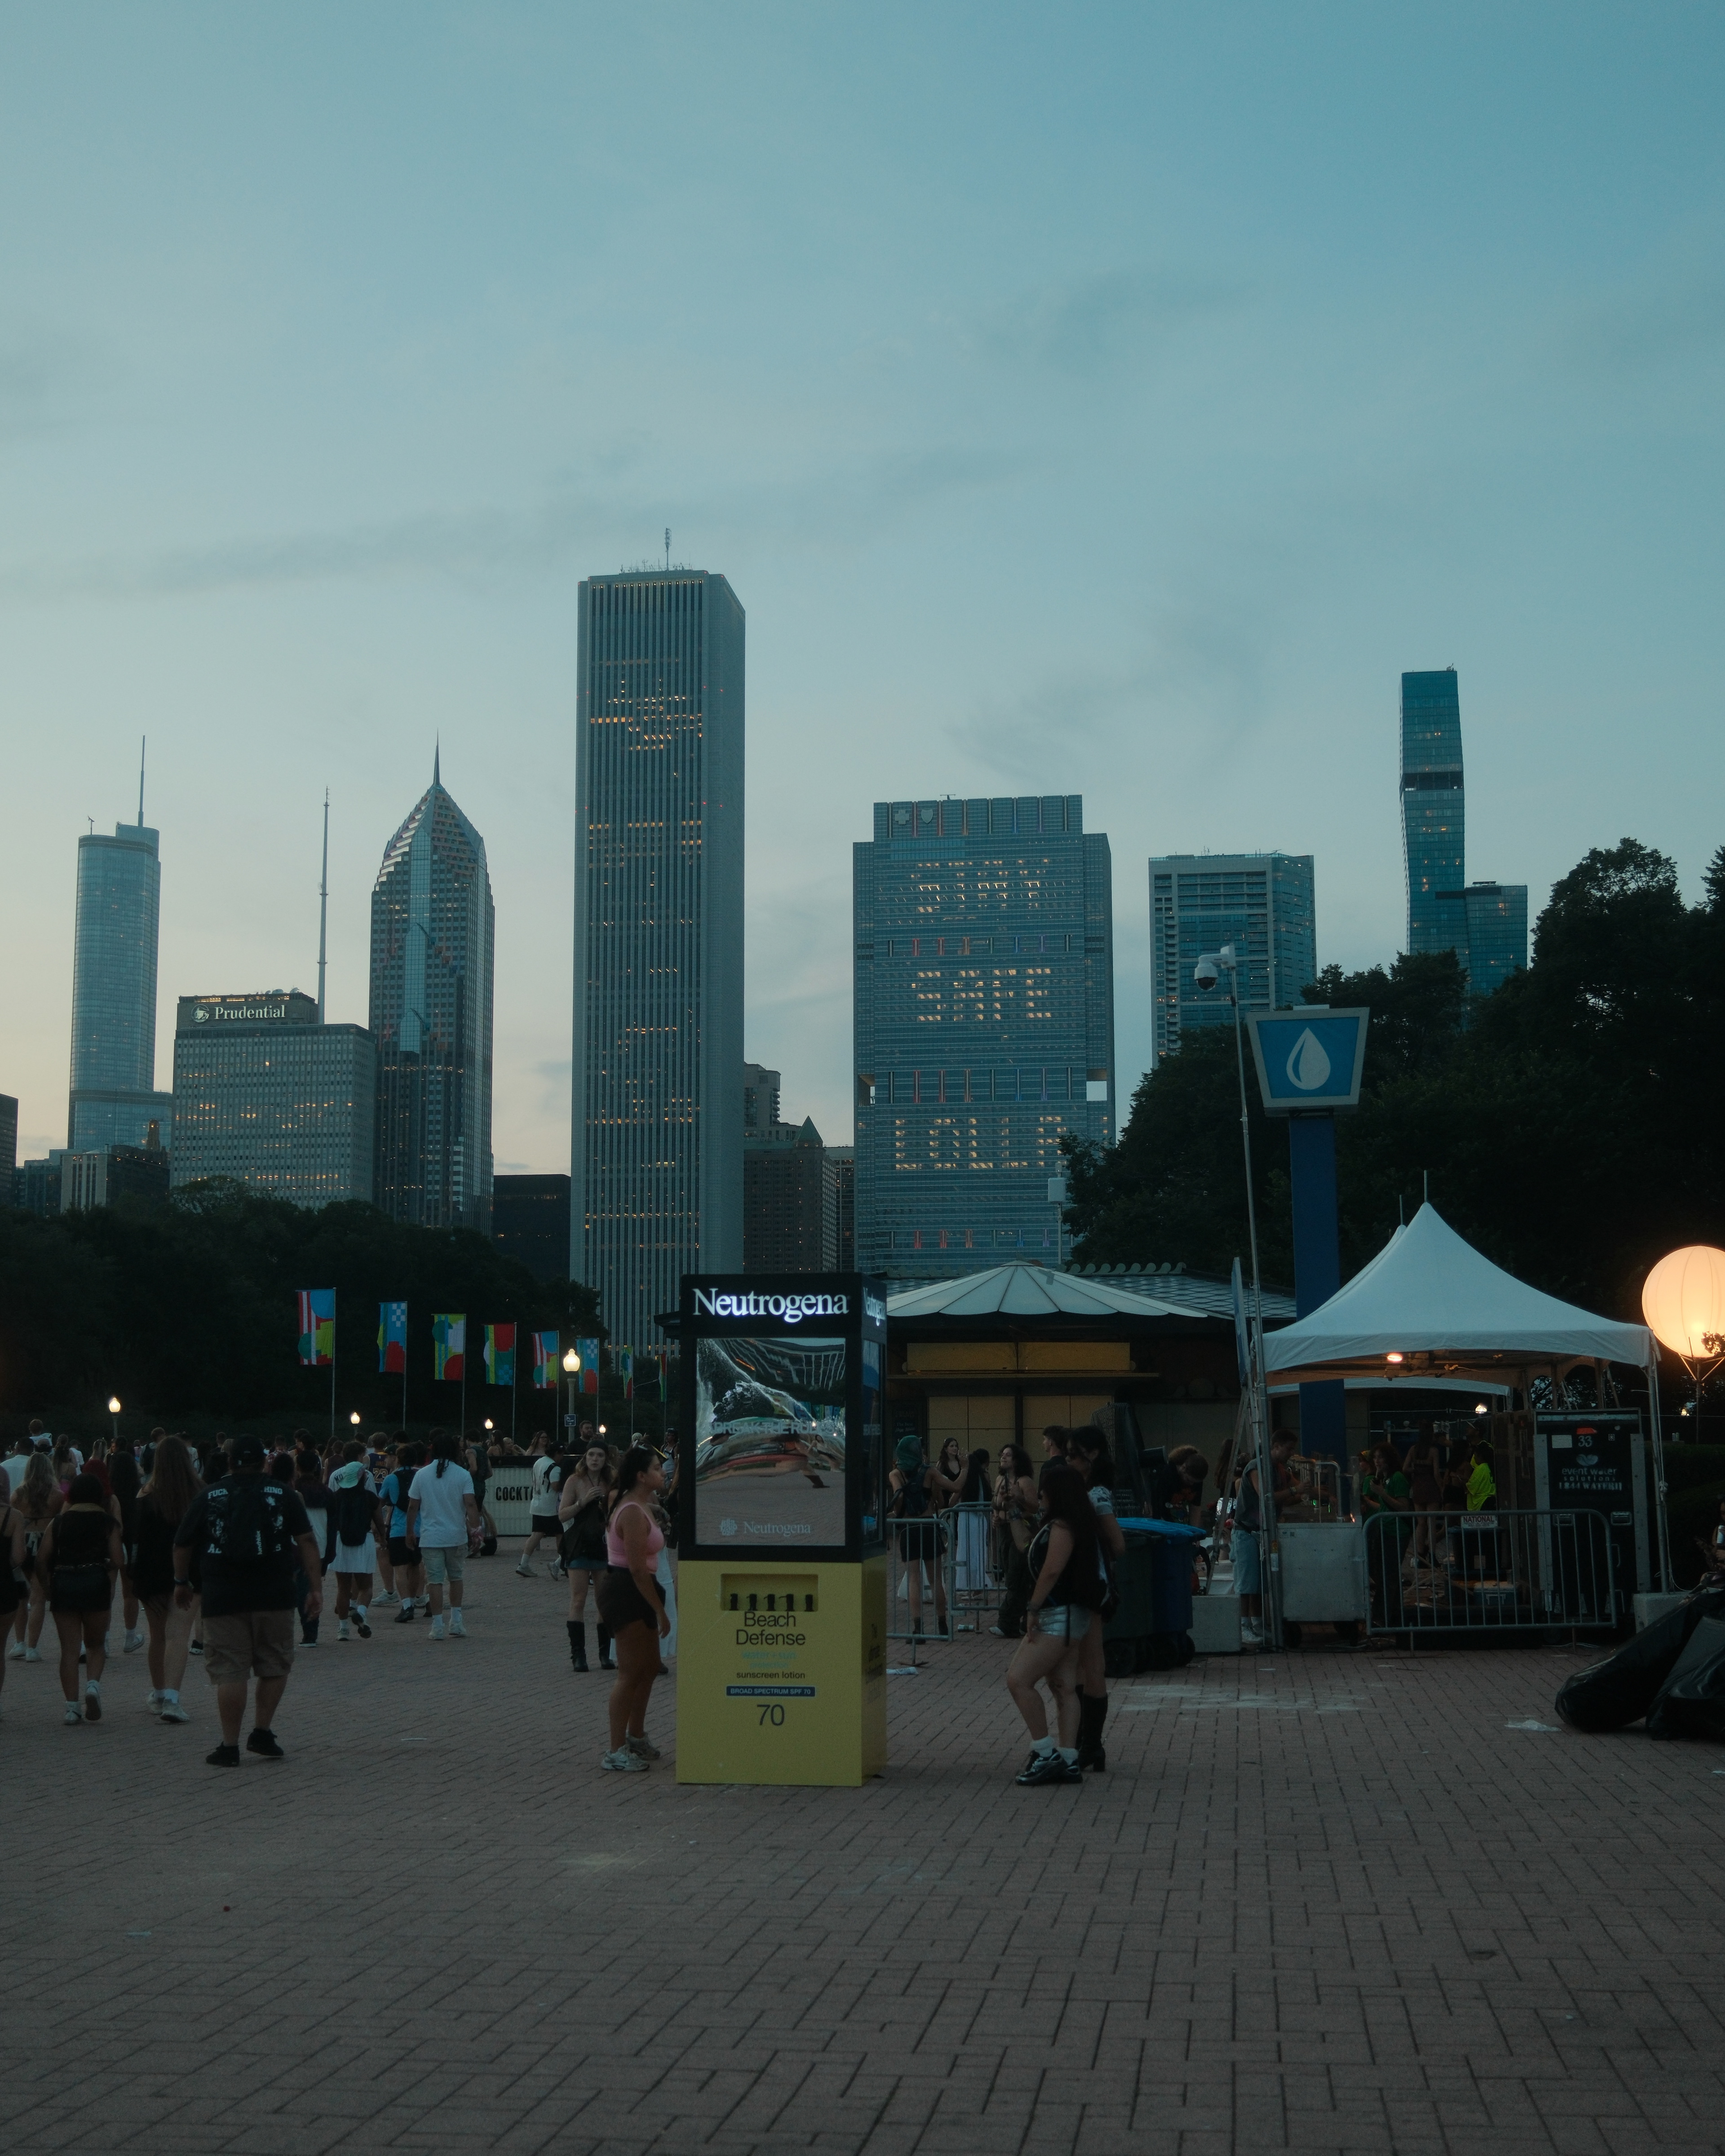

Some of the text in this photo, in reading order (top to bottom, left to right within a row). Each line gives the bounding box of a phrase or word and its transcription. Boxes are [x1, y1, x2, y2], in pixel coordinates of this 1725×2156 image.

[214, 1005, 286, 1020] Prudential
[691, 1287, 850, 1323] Neutrogena
[1578, 1435, 1593, 1448] 33
[1561, 1467, 1588, 1476] event
[743, 1520, 811, 1537] Neutrogena
[744, 1611, 796, 1627] Beach
[736, 1629, 806, 1646] Defense
[782, 1671, 805, 1679] lotion
[756, 1704, 785, 1726] 70
